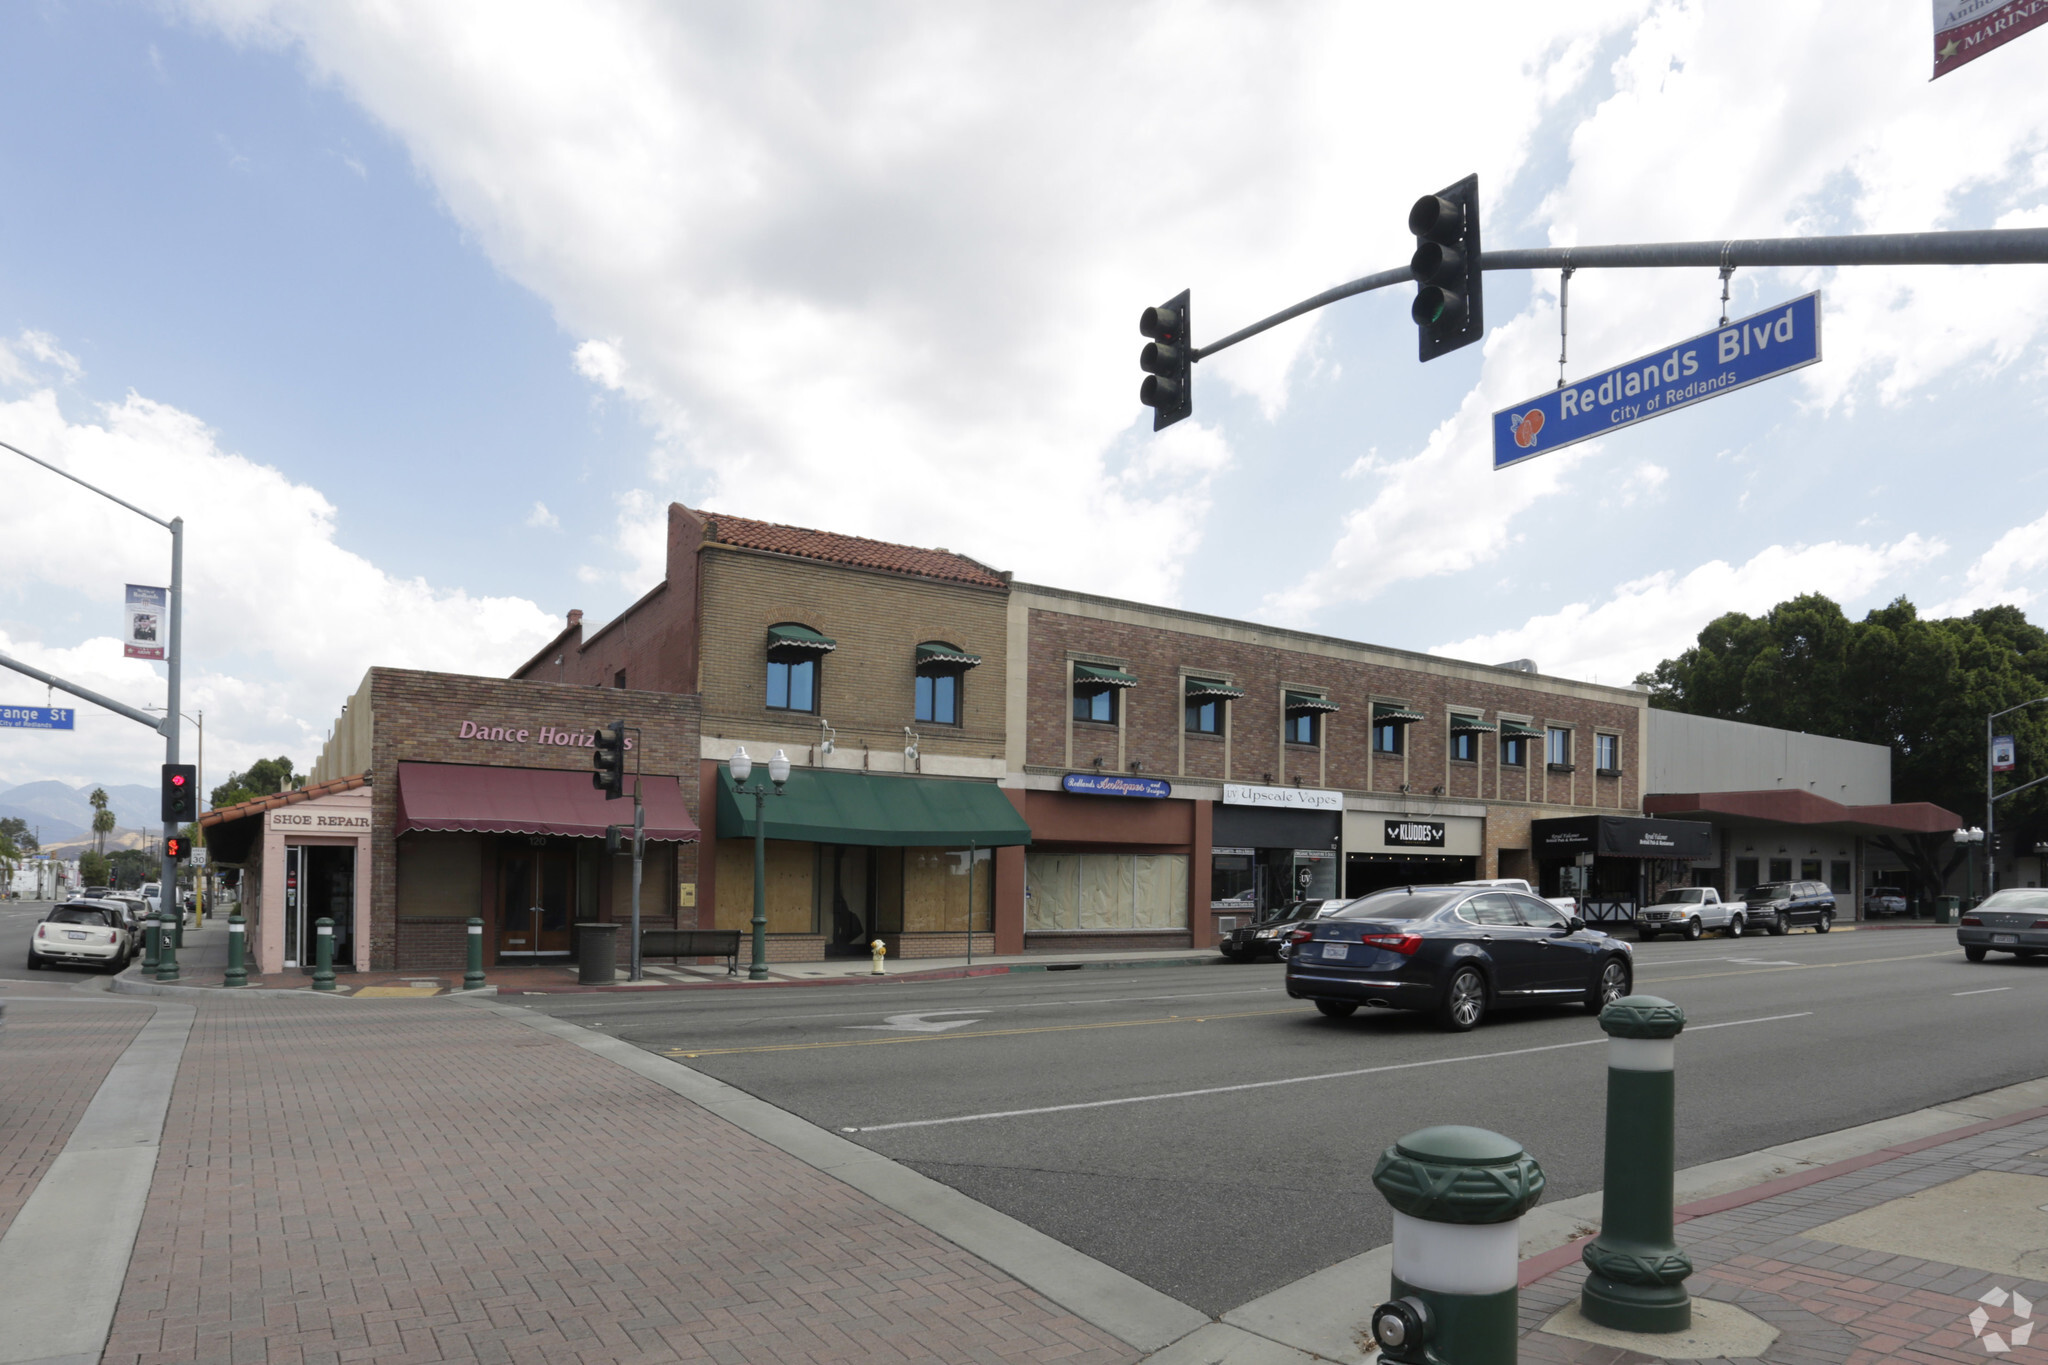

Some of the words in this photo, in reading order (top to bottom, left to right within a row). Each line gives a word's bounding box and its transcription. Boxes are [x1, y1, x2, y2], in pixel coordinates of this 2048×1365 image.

[1560, 349, 1699, 421] Redlands
[1718, 306, 1794, 365] Blvd
[1610, 404, 1641, 424] City
[1646, 394, 1661, 412] of
[1666, 371, 1738, 405] Redlands
[50, 709, 67, 722] St
[459, 720, 529, 743] Dance
[538, 726, 633, 751] Horizs
[1068, 778, 1095, 788] Redlands
[1097, 777, 1145, 795] Antiques
[1145, 787, 1166, 796] Designs
[1241, 788, 1293, 804] Upscale
[1298, 791, 1337, 808] Vapes
[273, 814, 312, 826] SHOE
[317, 816, 370, 827] REPAIR
[1400, 822, 1432, 842] KLÜDDES
[192, 856, 204, 864] 30
